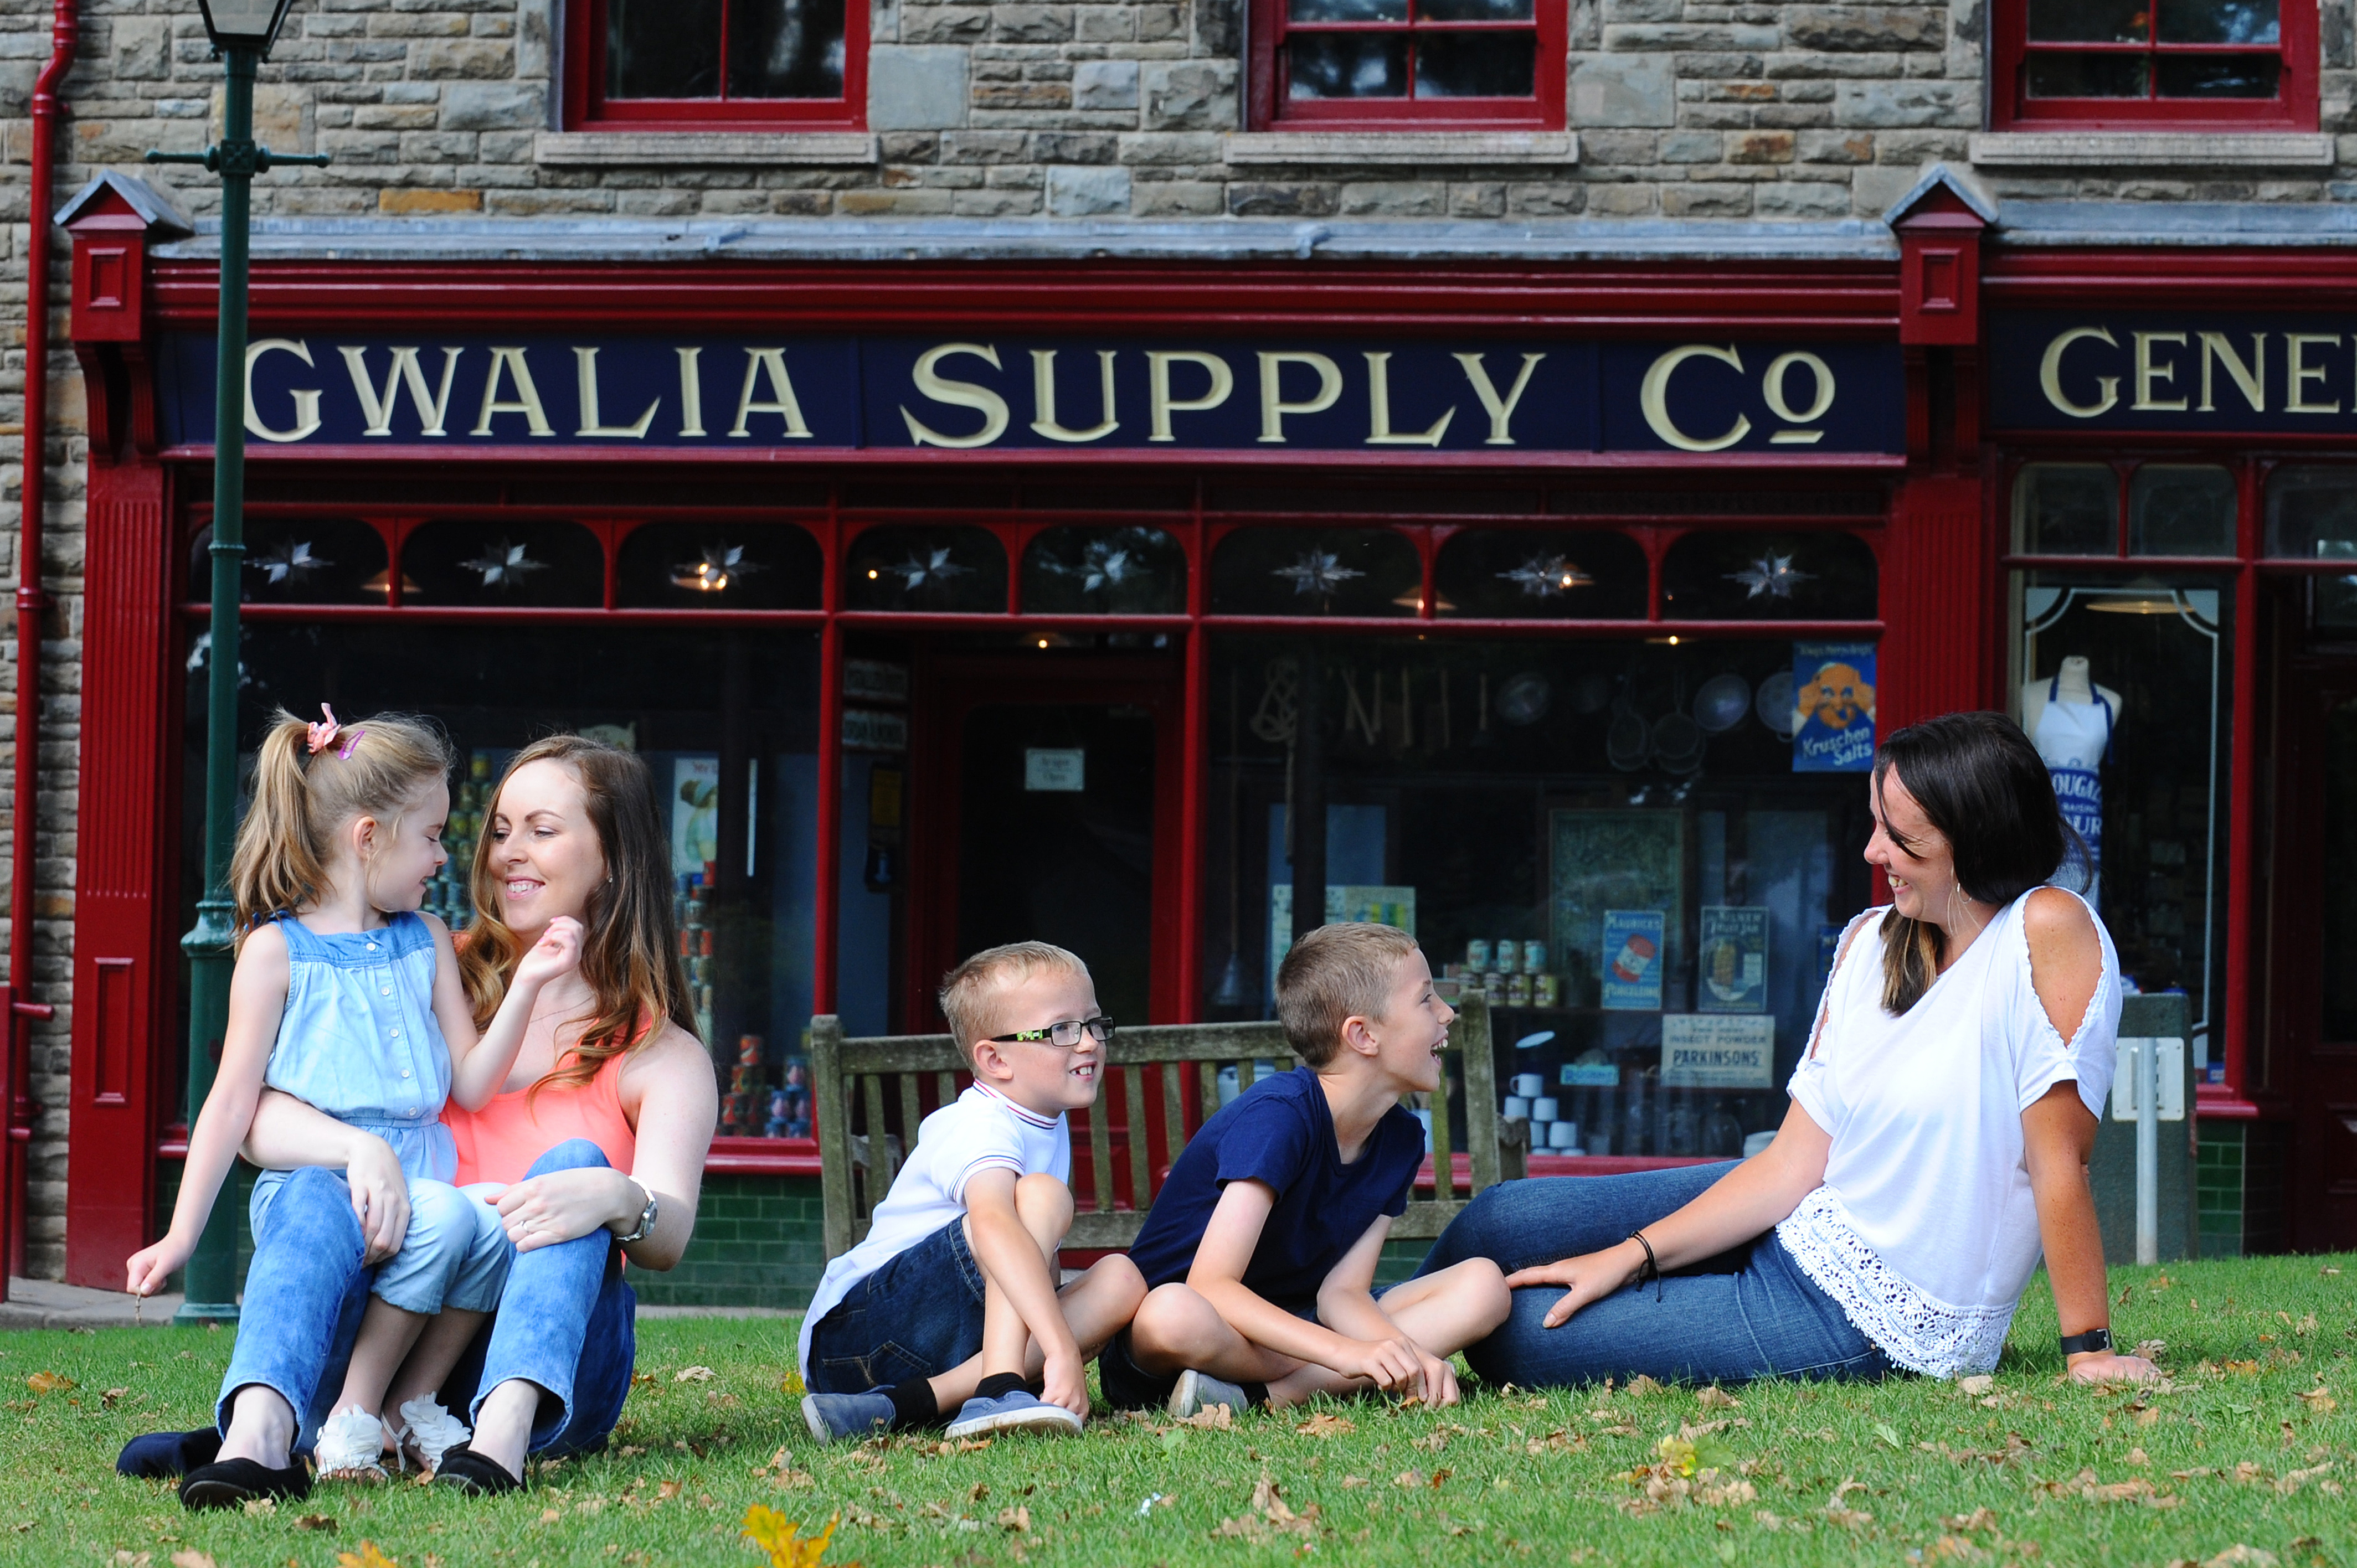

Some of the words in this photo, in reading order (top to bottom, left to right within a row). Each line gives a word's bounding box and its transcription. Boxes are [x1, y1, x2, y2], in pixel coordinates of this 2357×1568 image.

[2039, 324, 2357, 418] GENE
[243, 339, 813, 442] GWALIA
[901, 344, 1545, 448] SUPPLY
[1803, 727, 1870, 759] Kruschen
[1833, 743, 1872, 766] Salts
[2052, 772, 2101, 802] OUGAL
